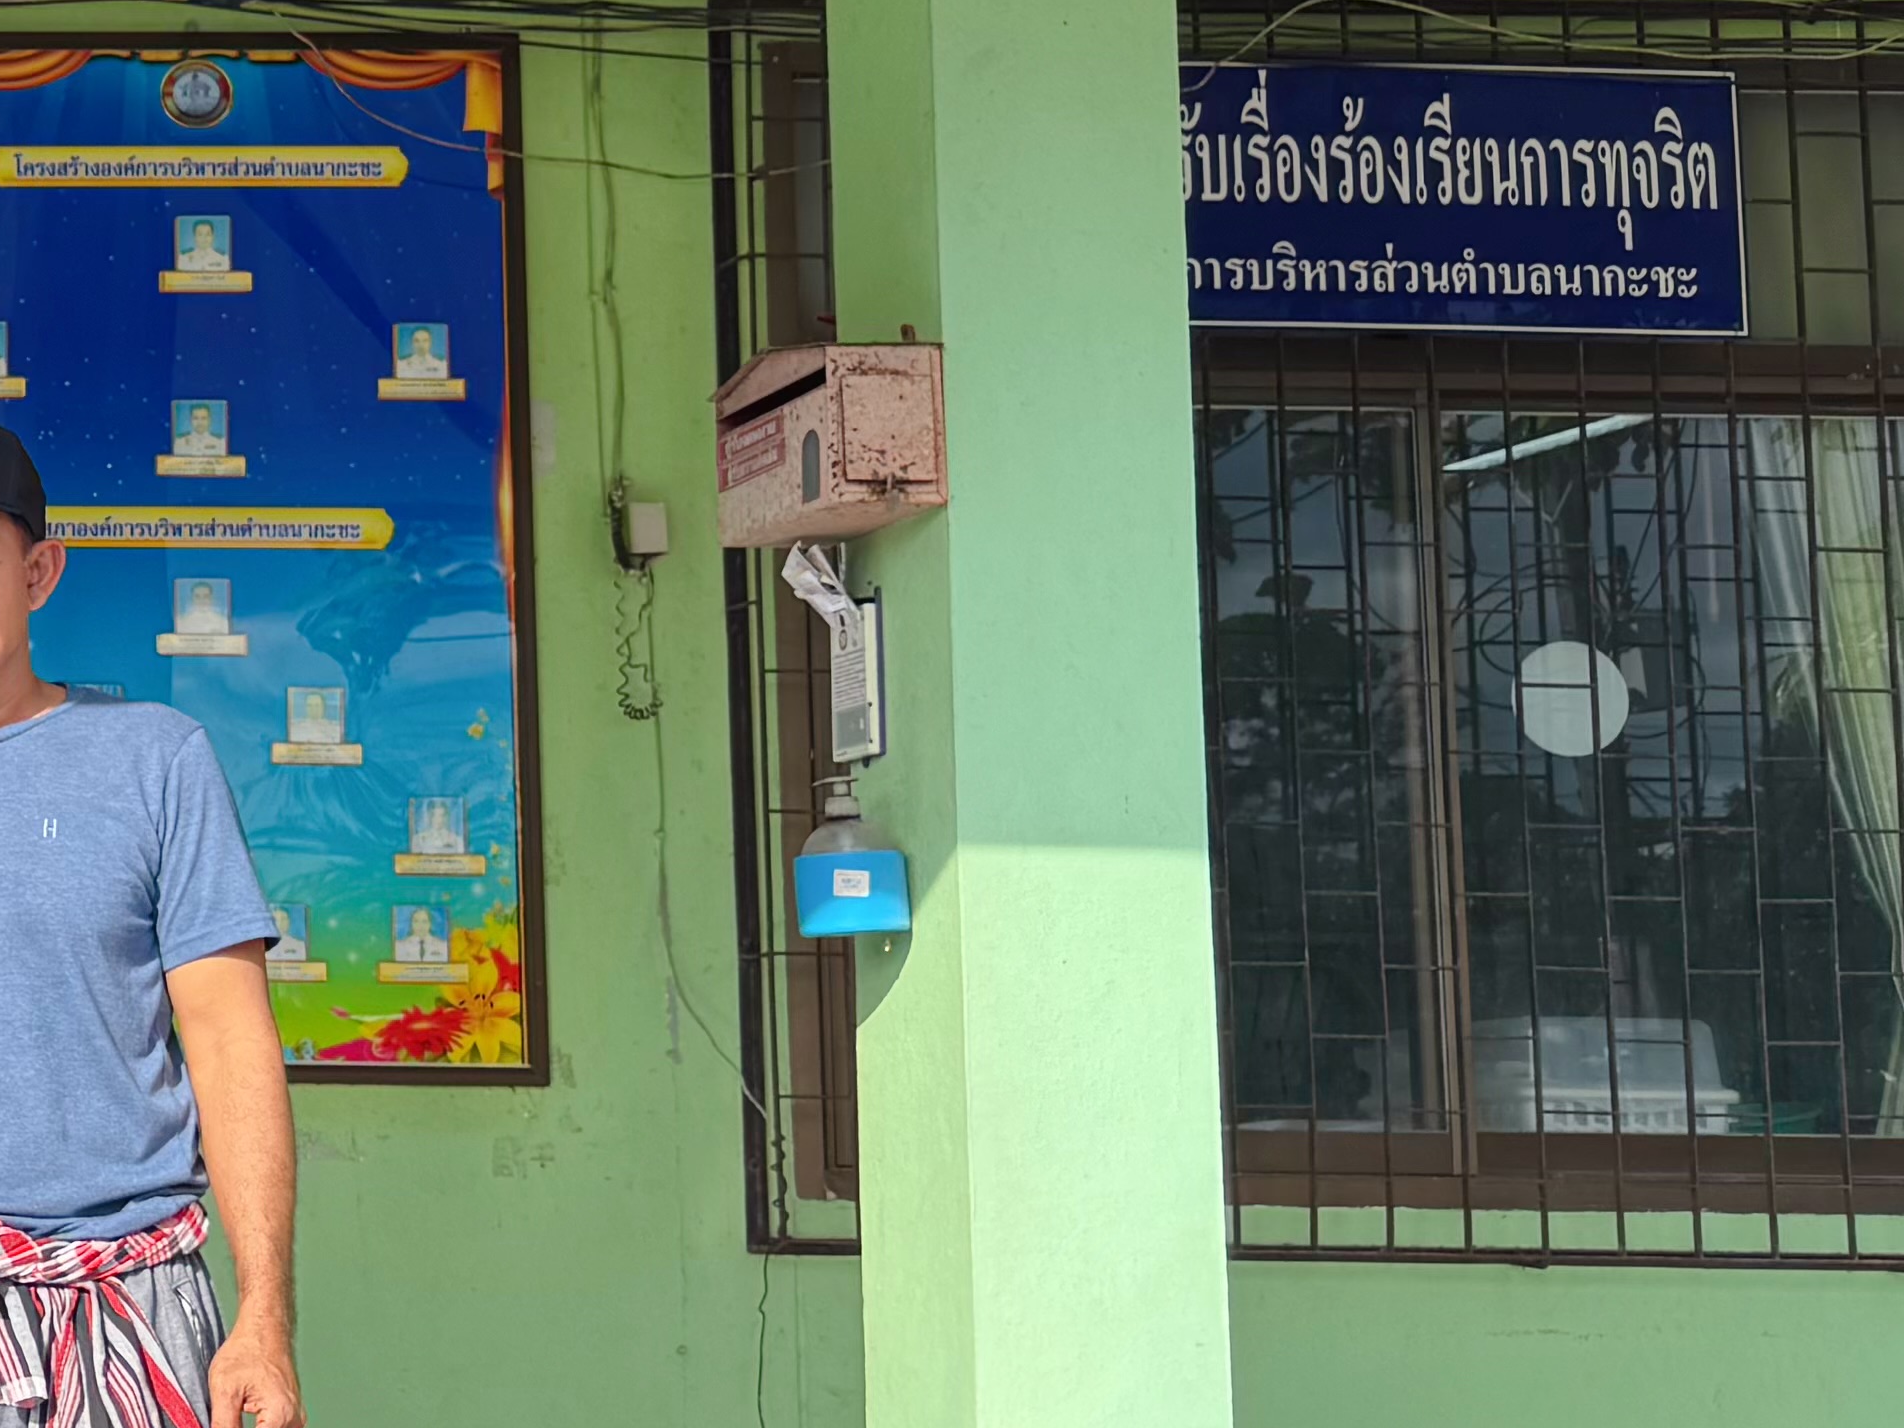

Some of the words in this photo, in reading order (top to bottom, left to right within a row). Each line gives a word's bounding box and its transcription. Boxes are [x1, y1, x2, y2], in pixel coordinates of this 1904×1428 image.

[47, 515, 361, 539] ภาองค์การบริหารส่วนตำบลนากะชะ
